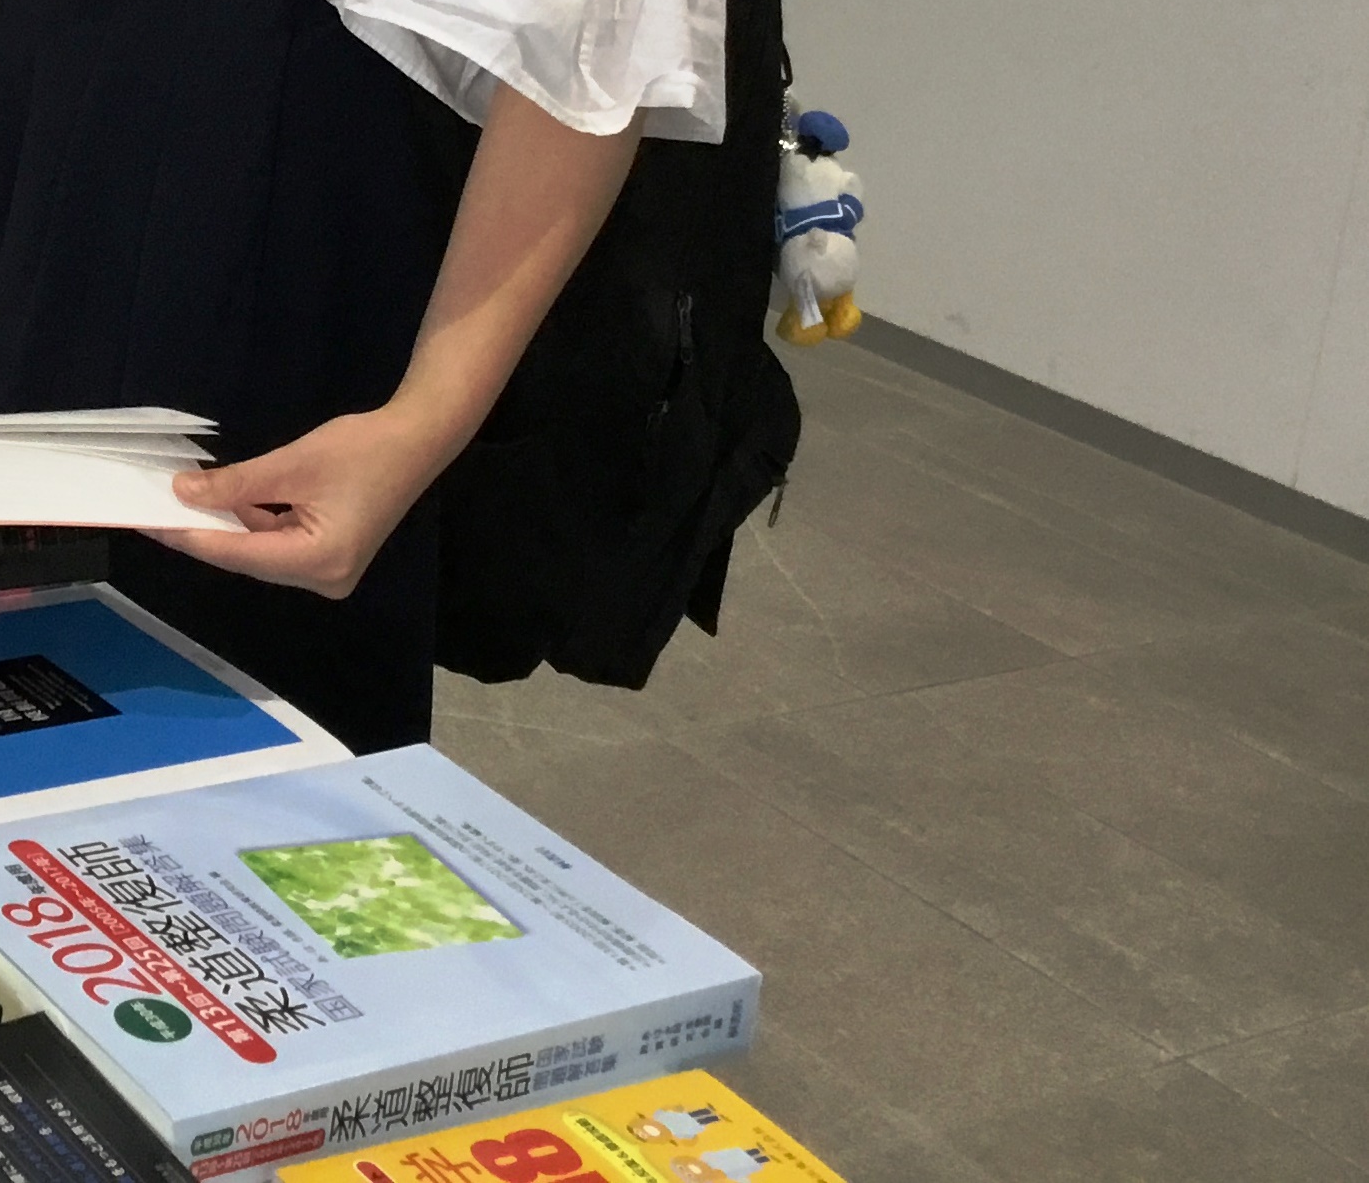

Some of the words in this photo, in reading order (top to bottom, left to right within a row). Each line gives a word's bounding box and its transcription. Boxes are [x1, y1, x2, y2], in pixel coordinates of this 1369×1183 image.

[0, 895, 145, 1008] 2018
[53, 838, 330, 1038] 柔道整復師
[235, 1108, 303, 1144] 2018
[328, 1052, 535, 1143] 柔道整復師
